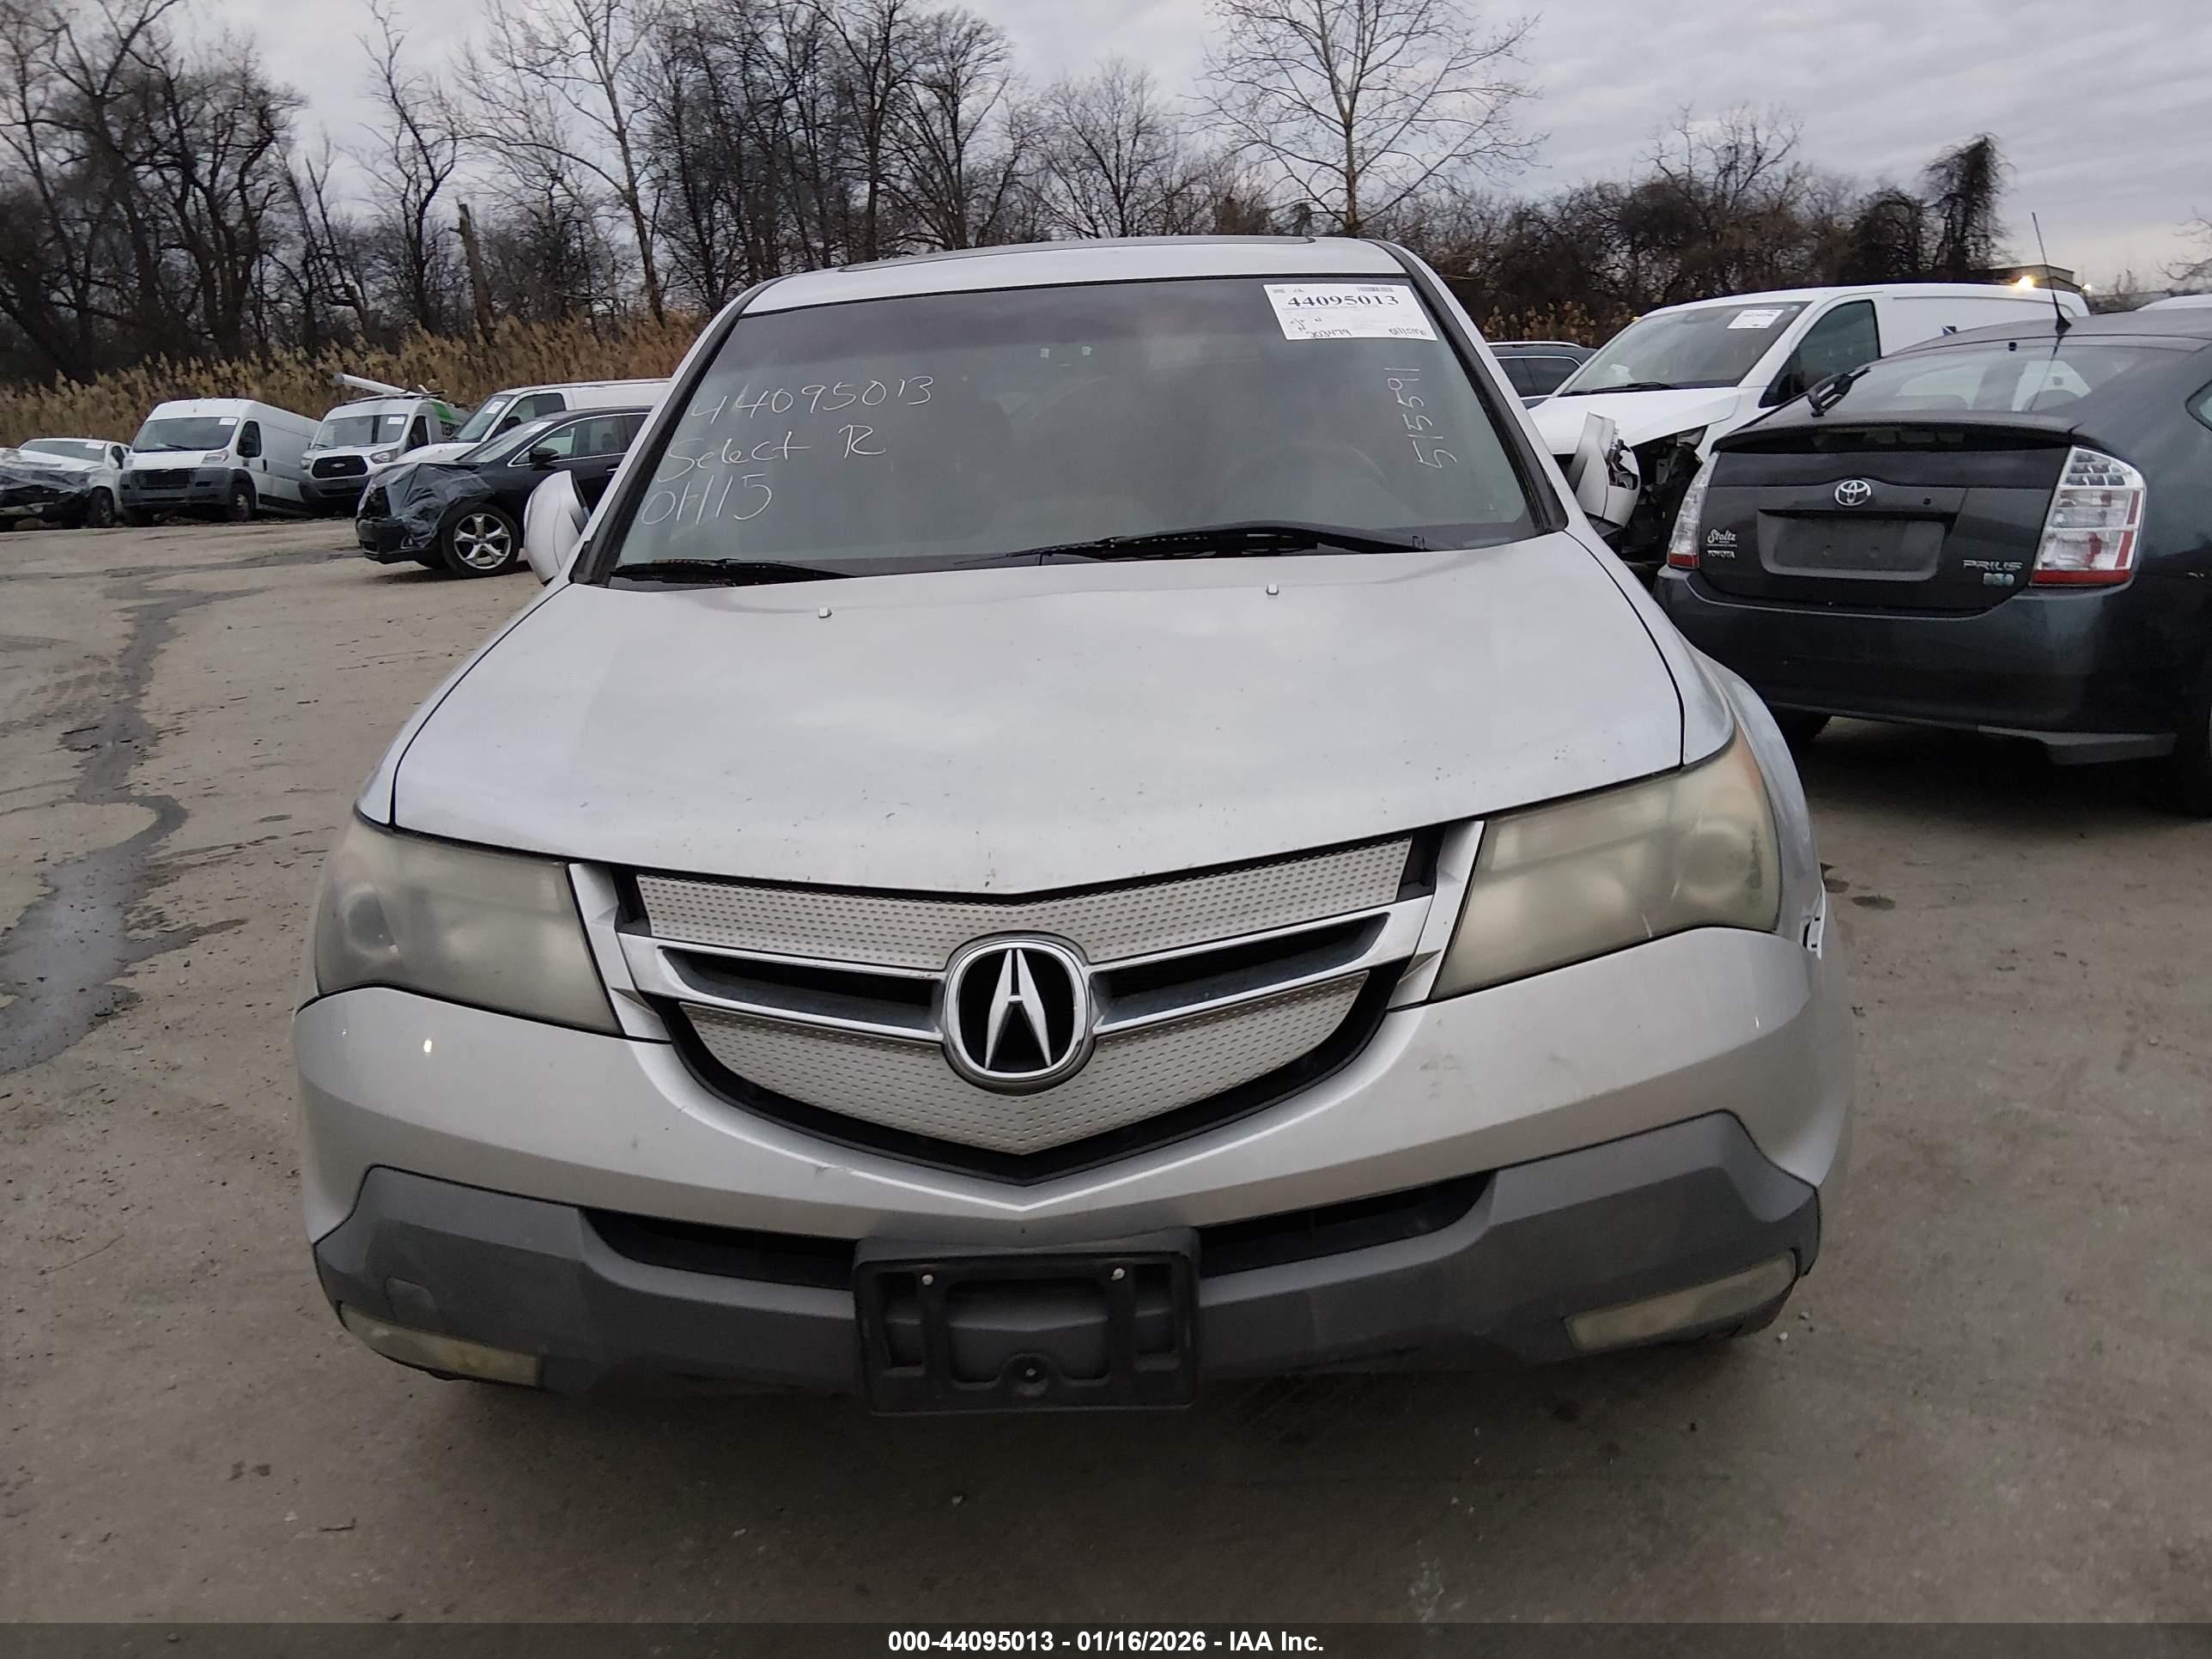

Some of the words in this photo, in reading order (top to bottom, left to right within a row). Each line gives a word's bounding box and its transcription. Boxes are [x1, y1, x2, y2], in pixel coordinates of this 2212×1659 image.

[1287, 295, 1400, 307] 44095013
[690, 375, 934, 425] 44095013
[656, 430, 811, 483] Select
[838, 423, 887, 459] R
[1962, 559, 2023, 571] PRIUS
